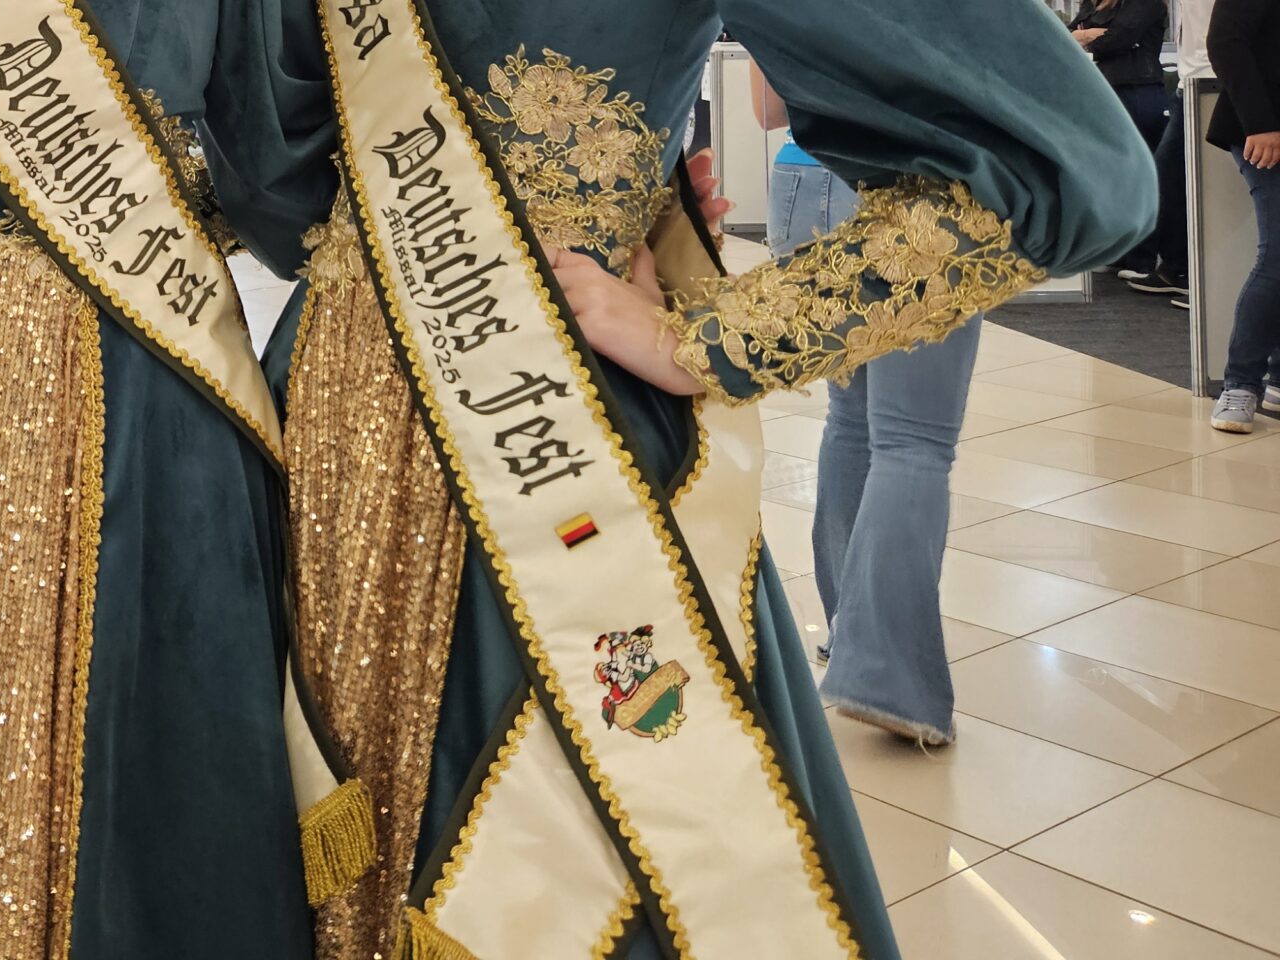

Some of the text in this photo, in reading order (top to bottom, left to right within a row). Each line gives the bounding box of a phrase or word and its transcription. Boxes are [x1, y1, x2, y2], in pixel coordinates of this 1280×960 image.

[59, 209, 108, 263] 2025
[108, 225, 219, 326] Fest
[372, 104, 596, 496] Deutsches Fest
[381, 206, 463, 384] Missal 2025
